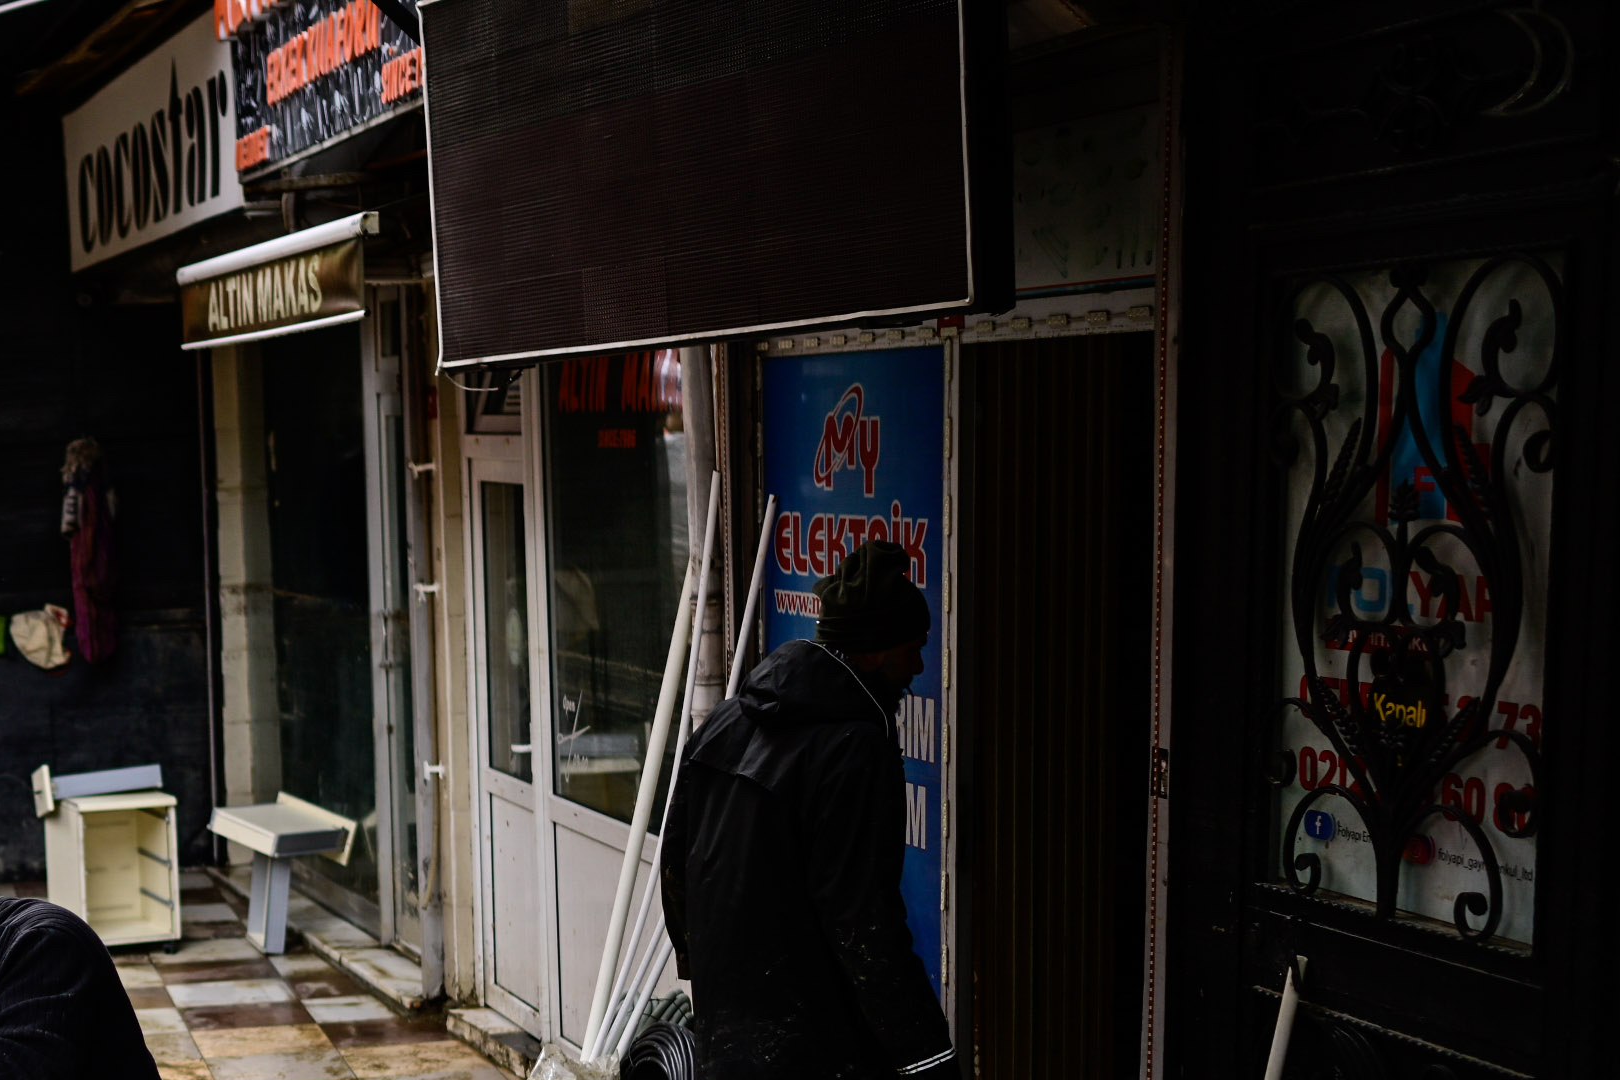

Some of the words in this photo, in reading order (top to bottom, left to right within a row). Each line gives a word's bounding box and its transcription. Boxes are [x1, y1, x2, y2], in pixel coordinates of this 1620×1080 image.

[79, 56, 228, 254] cocostar
[208, 272, 255, 332] ALTIN
[256, 254, 323, 323] MAKAS
[1442, 772, 1486, 826] 60
